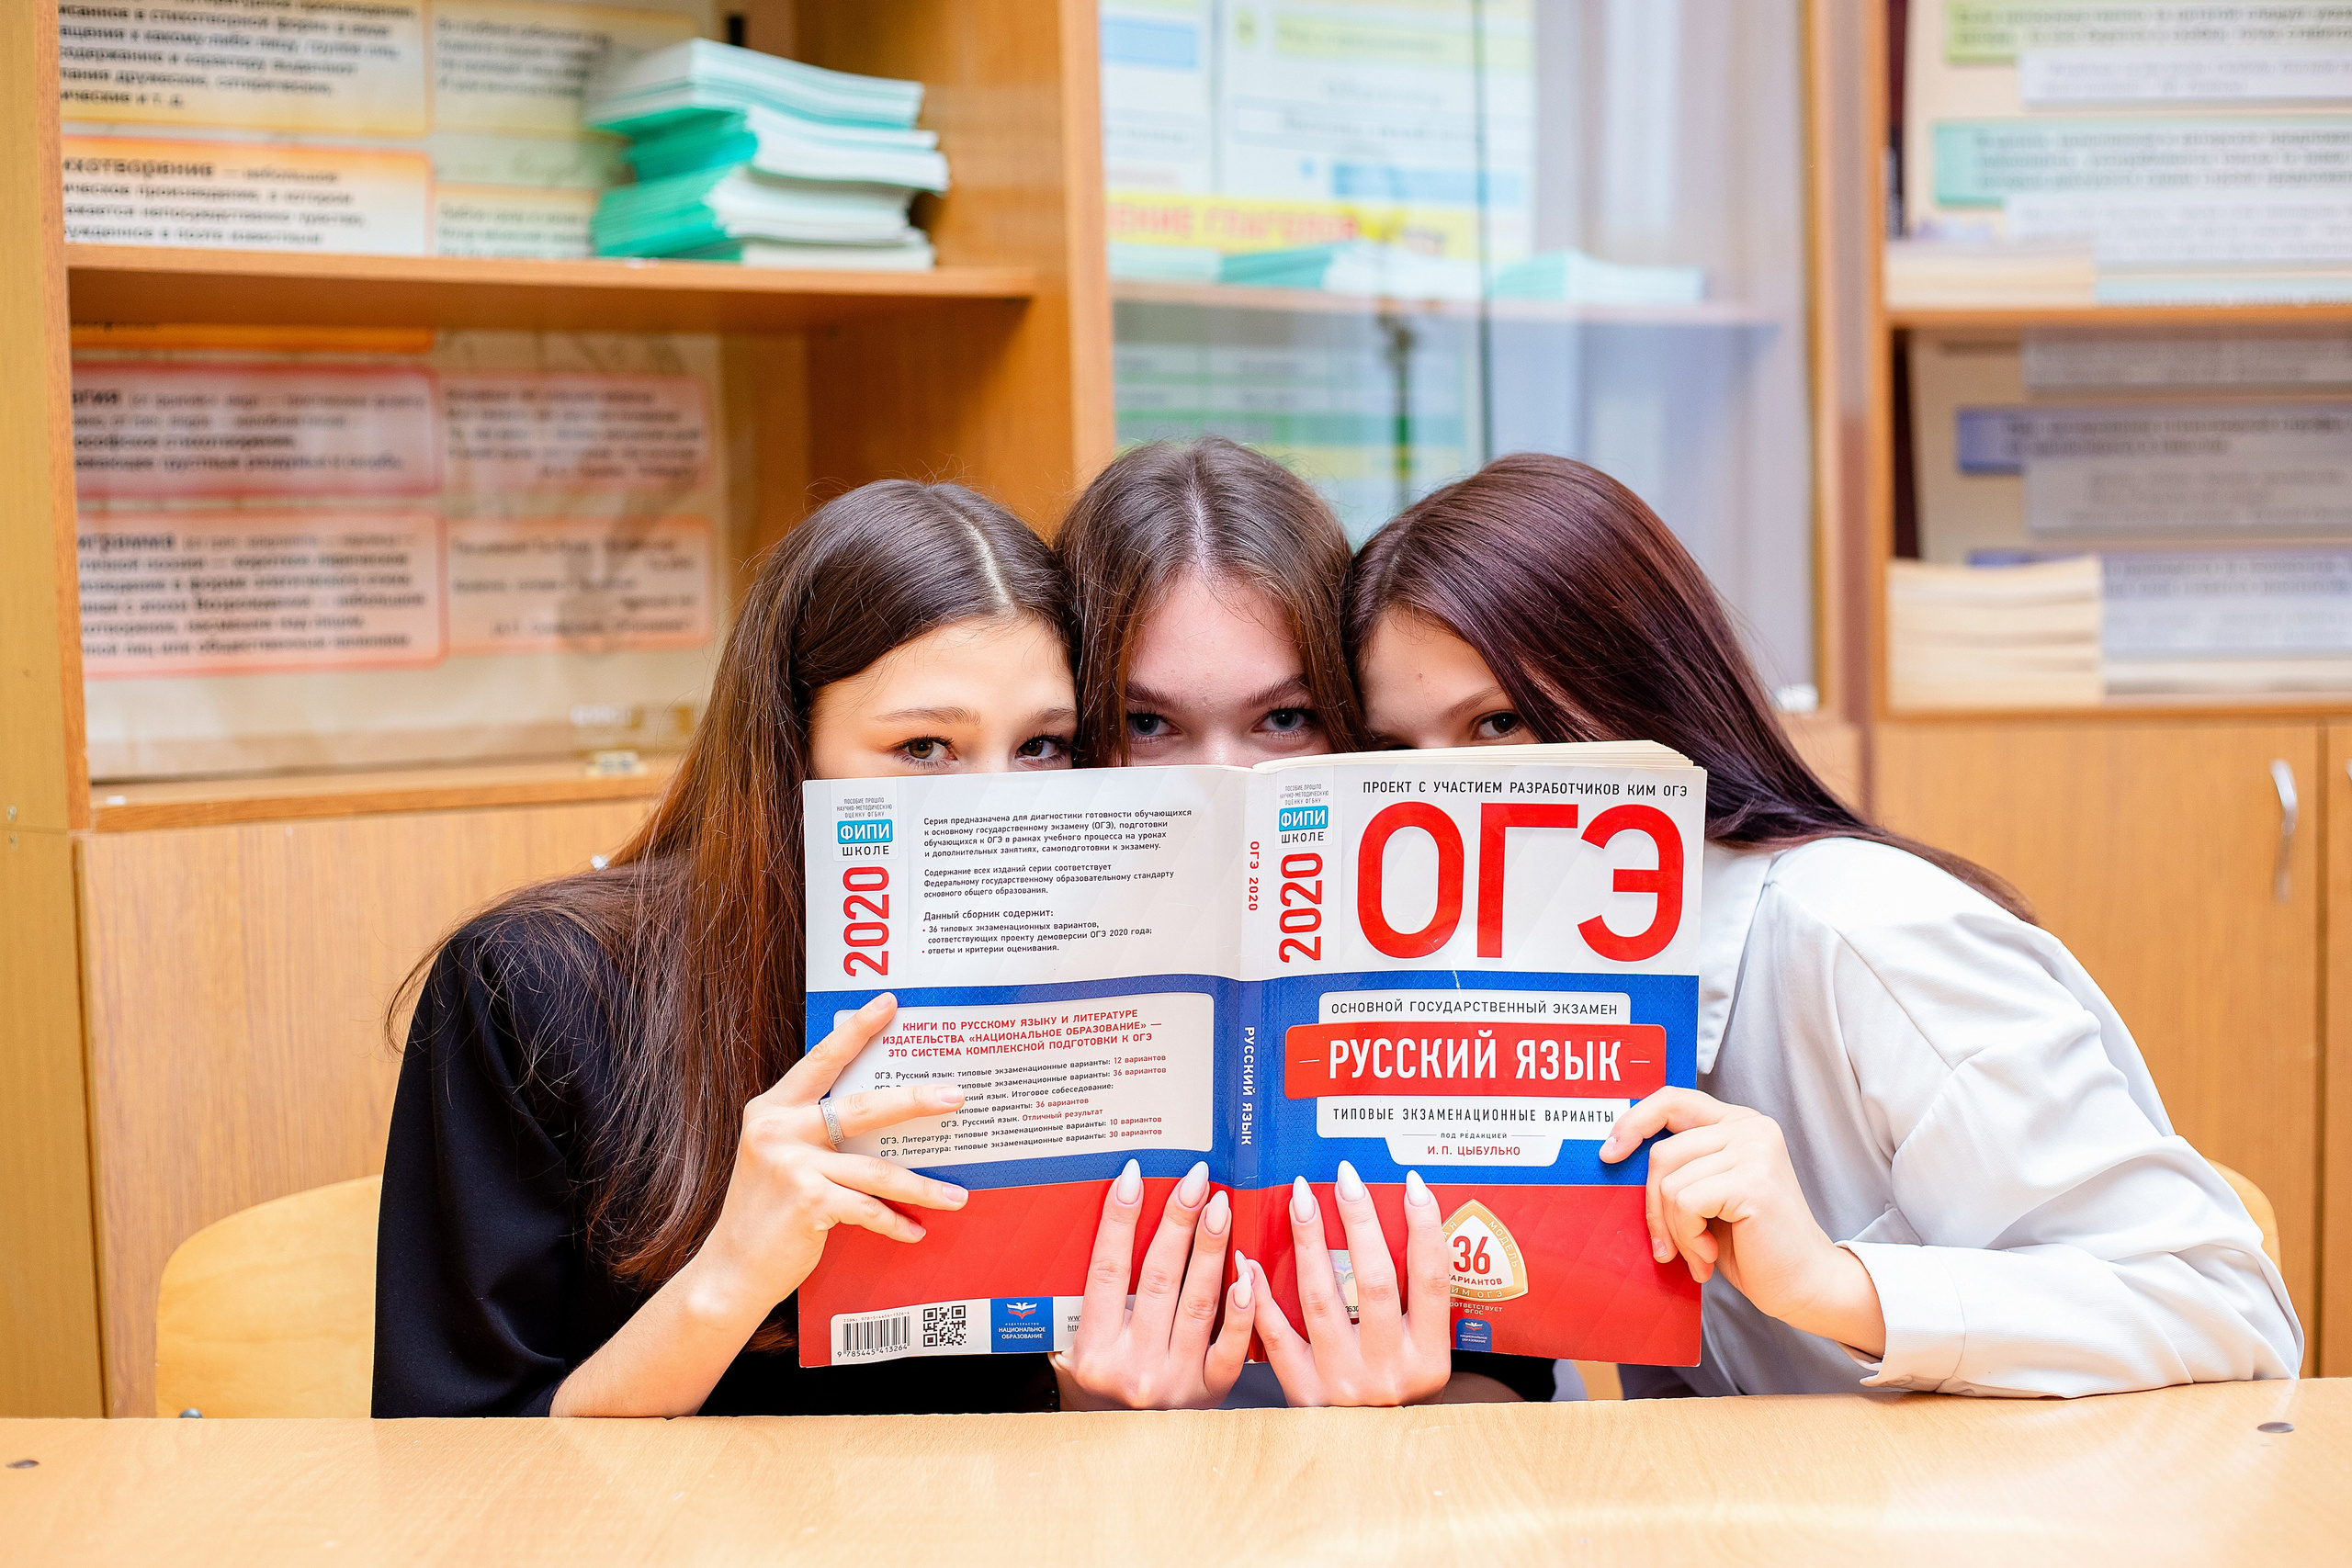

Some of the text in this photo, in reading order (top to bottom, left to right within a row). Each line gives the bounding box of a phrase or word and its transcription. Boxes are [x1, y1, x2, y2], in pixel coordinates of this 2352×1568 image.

[1363, 781, 1687, 796] ПРОЕКТ С УЧАСТИЕМ РАЗРАБОТЧИКОВ КИМ ОГЭ
[923, 818, 948, 827] Серия
[950, 815, 1010, 826] предназначена
[1029, 813, 1082, 821] диагностики
[1134, 809, 1192, 819] обучающихся
[1280, 809, 1326, 828] ФИПИ
[840, 823, 890, 840] ФИПИ
[932, 828, 974, 837] основному
[976, 825, 1048, 835] государственному
[1050, 823, 1090, 831] экзамену
[1091, 820, 1116, 829] (ОГЭ),
[1119, 821, 1168, 829] подготовки
[1282, 831, 1324, 843] ШКОЛЕ
[923, 839, 978, 848] обучающихся
[987, 835, 1002, 843] ОГЭ
[1012, 836, 1041, 844] рамках
[1044, 833, 1081, 843] учебного
[1084, 833, 1123, 841] процесса
[1137, 831, 1167, 840] уроках
[842, 845, 889, 856] ШКОЛЕ
[932, 848, 998, 858] дополнительных
[1000, 846, 1039, 854] занятиях,
[1120, 842, 1161, 851] экзамену.
[924, 868, 971, 877] Содержание
[992, 864, 1025, 874] изданий
[1028, 865, 1052, 874] серии
[1054, 863, 1112, 872] соответствует
[1248, 840, 1260, 911] ОГЭ 2020
[923, 871, 1174, 887] Федеральному государственному образовательному стандарту
[1357, 801, 1685, 963] ОГЭ
[923, 886, 1048, 898] основного общего образования.
[922, 909, 1053, 921] Данный сборник содержит:
[1278, 852, 1323, 964] 2020
[842, 866, 889, 976] 2020
[928, 925, 937, 933] 36
[976, 923, 1051, 931] экзаменационных
[1053, 921, 1099, 931] вариантов,
[927, 935, 998, 943] соответствующих
[1001, 934, 1035, 942] проекту
[1036, 932, 1088, 942] демоверсии
[1090, 930, 1106, 938] ОГЭ
[1109, 928, 1128, 937] 2020
[965, 946, 1003, 954] критерии
[1006, 944, 1059, 953] оценивания.
[1331, 998, 1617, 1015] ОСНОВНОЙ ГОСУДАРСТВЕННЫЙ ЭКЗАМЕН
[902, 1009, 1137, 1031] КНИГИ ПО РУССКОМУ ЯЗЫКУ И ЛИТЕРАТУРЕ
[882, 1021, 1147, 1045] ИЗДАТЕЛЬСТВА «НАЦИОНАЛЬНОЕ ОБРАЗОВАНИЕ»
[888, 1032, 1152, 1057] ЭТО СИСТЕМА КОМПЛЕКСНОЙ ПОДГОТОВКИ К ОГЭ
[1329, 1030, 1622, 1082] РУССКИЙ ЯЗЫК
[875, 1071, 893, 1079] ОГЭ.
[895, 1070, 930, 1080] Русский
[994, 1063, 1068, 1074] экзаменационные
[1069, 1059, 1110, 1069] варианты:
[1125, 1055, 1166, 1064] вариантов
[994, 1075, 1068, 1087] экзаменационные
[1069, 1071, 1110, 1081] варианты:
[1113, 1068, 1123, 1077] 36
[1125, 1067, 1167, 1077] вариантов
[1012, 1089, 1049, 1098] Итоговое
[1241, 1027, 1256, 1145] РУССКИЙ ЯЗЫК
[991, 1103, 1033, 1112] варианты:
[1047, 1098, 1089, 1108] вариантов
[940, 1120, 959, 1128] ОГЭ.
[962, 1116, 994, 1128] Русский
[1022, 1111, 1062, 1122] Отличный
[1064, 1109, 1103, 1119] результат
[1332, 1108, 1613, 1122] ТИПОВЫЕ ЭКЗАМЕНАЦИОННЫЕ ВАРИАНТЫ
[880, 1129, 1162, 1157] ОГЭ. Литература: типовые экзаменационные варианты: 30 вариантов
[1428, 1145, 1520, 1156] И. П. ЦЫБУЛЬКО
[1488, 1221, 1520, 1268] МОДЕЛЬ
[1453, 1235, 1491, 1274] 36
[1449, 1275, 1503, 1285] АРИАНТОВ
[1452, 1287, 1470, 1296] ИМ
[1450, 1303, 1503, 1312] ООТВЕТСТВУЕТ
[846, 1348, 876, 1358] 785445
[879, 1345, 908, 1354] 413264
